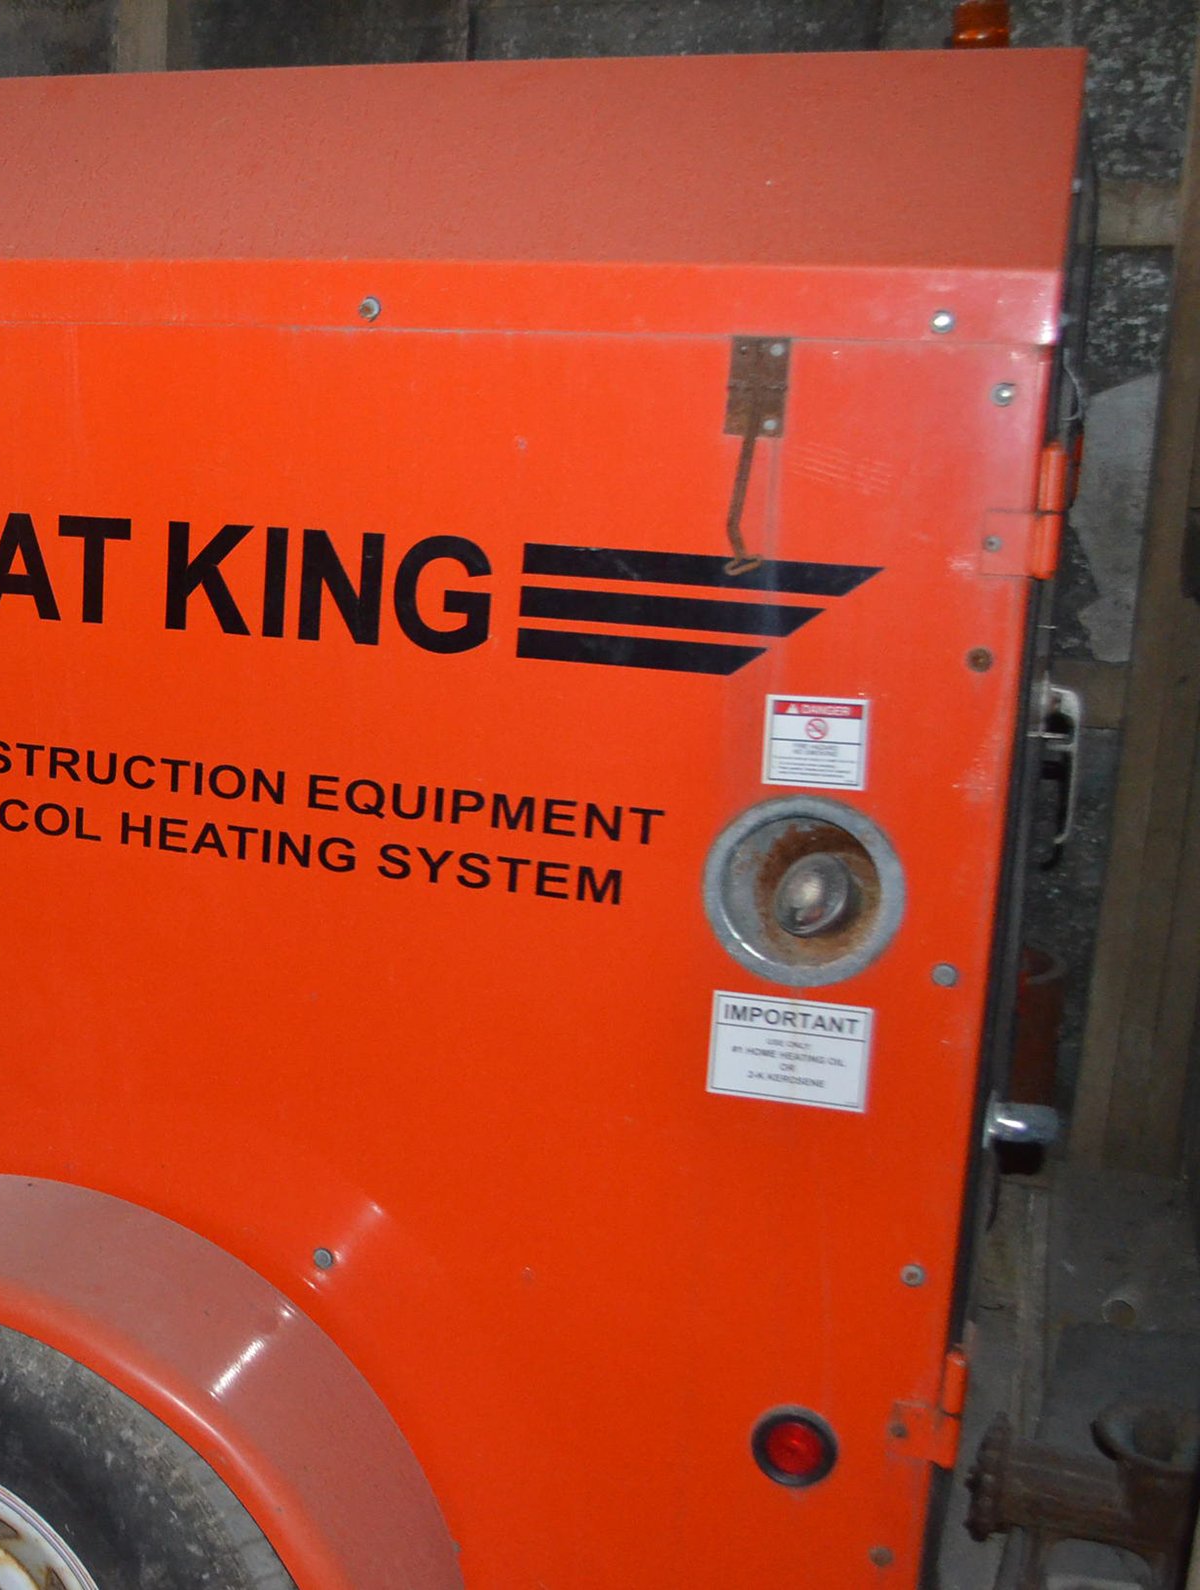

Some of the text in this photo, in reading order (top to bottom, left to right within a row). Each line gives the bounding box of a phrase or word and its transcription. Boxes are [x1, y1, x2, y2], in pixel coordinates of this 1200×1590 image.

[164, 520, 492, 655] KING
[307, 774, 666, 845] EQUIPMENT
[120, 811, 356, 873] HEATING
[377, 843, 623, 906] SYSTEM
[723, 1003, 860, 1035] IMPORTANT
[767, 1073, 826, 1088] KEROSENE
[779, 1051, 825, 1065] HEATING
